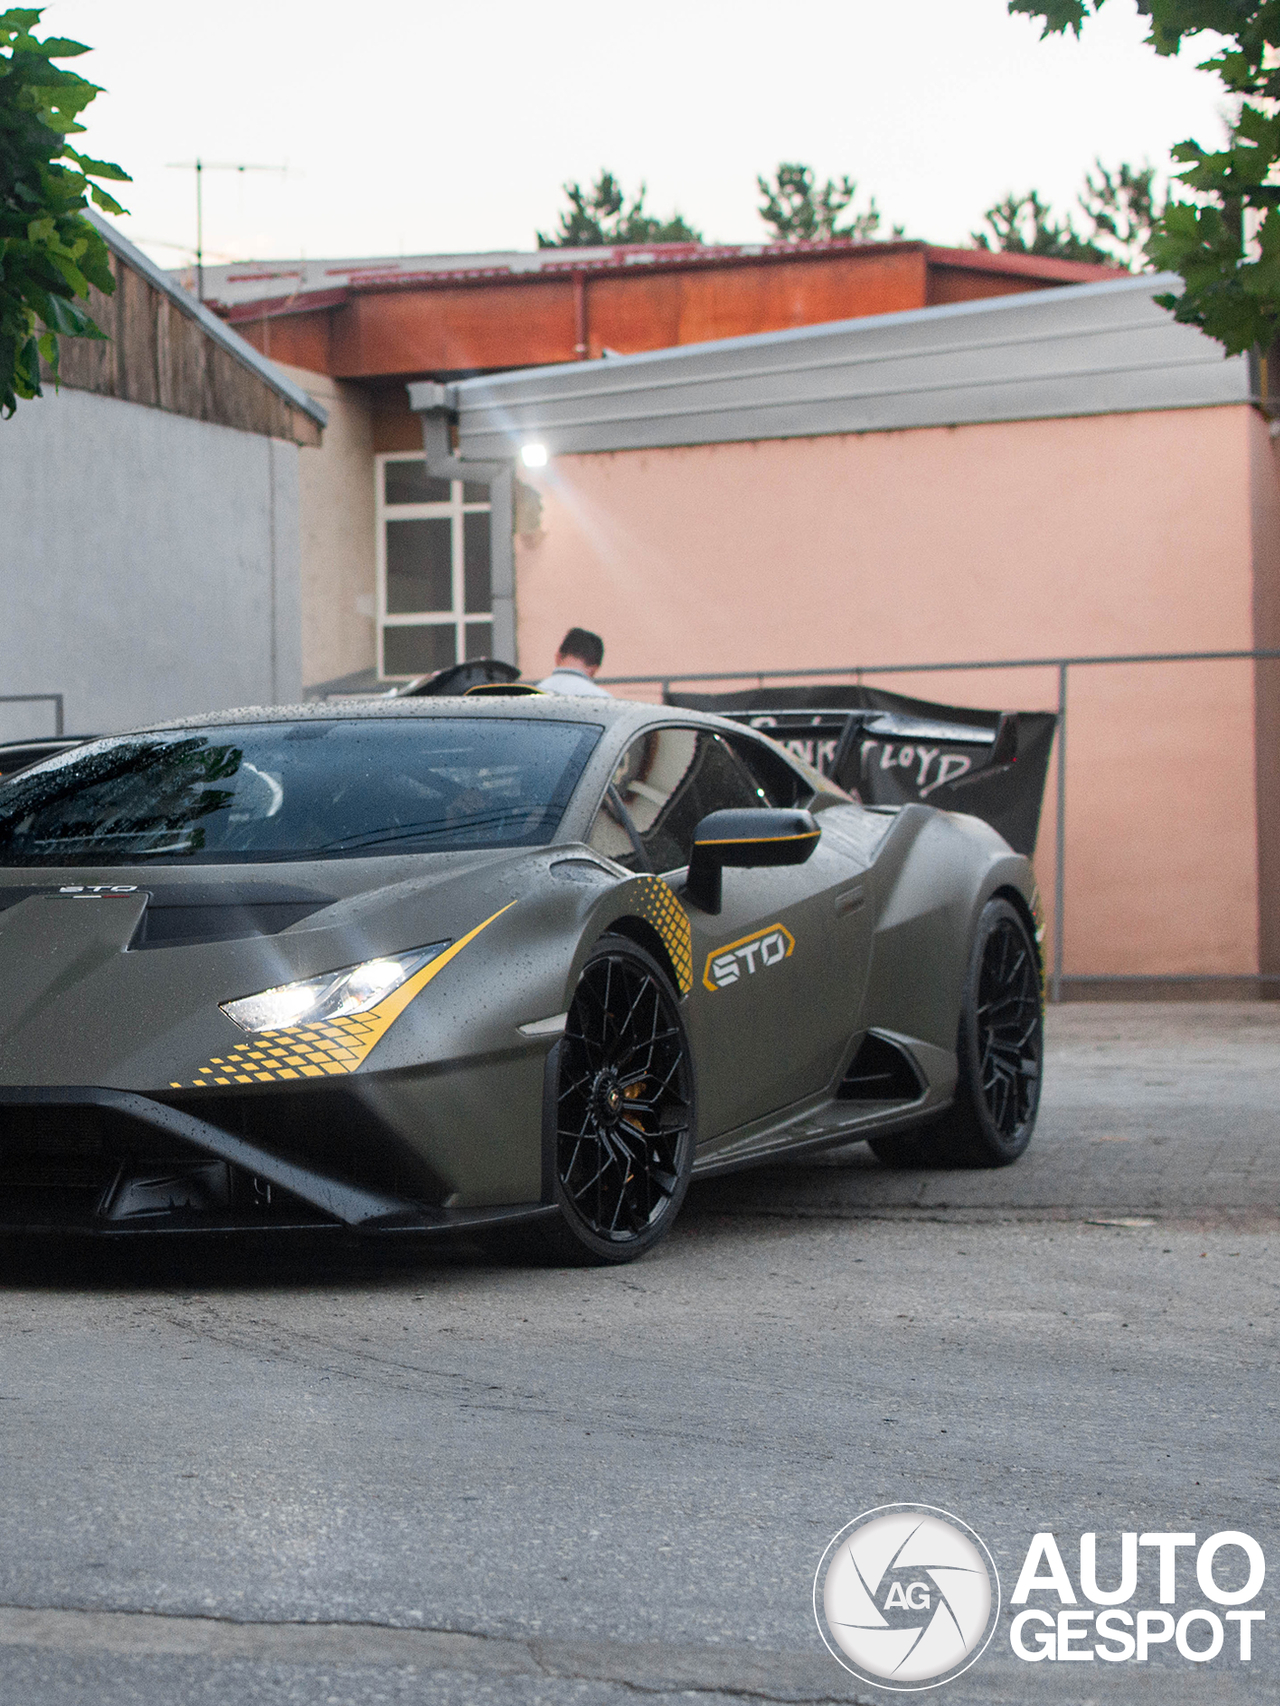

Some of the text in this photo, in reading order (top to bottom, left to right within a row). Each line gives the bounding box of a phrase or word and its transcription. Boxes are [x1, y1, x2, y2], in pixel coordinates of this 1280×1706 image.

[861, 740, 970, 798] FLOYD
[59, 885, 138, 893] STO
[712, 933, 785, 987] STO
